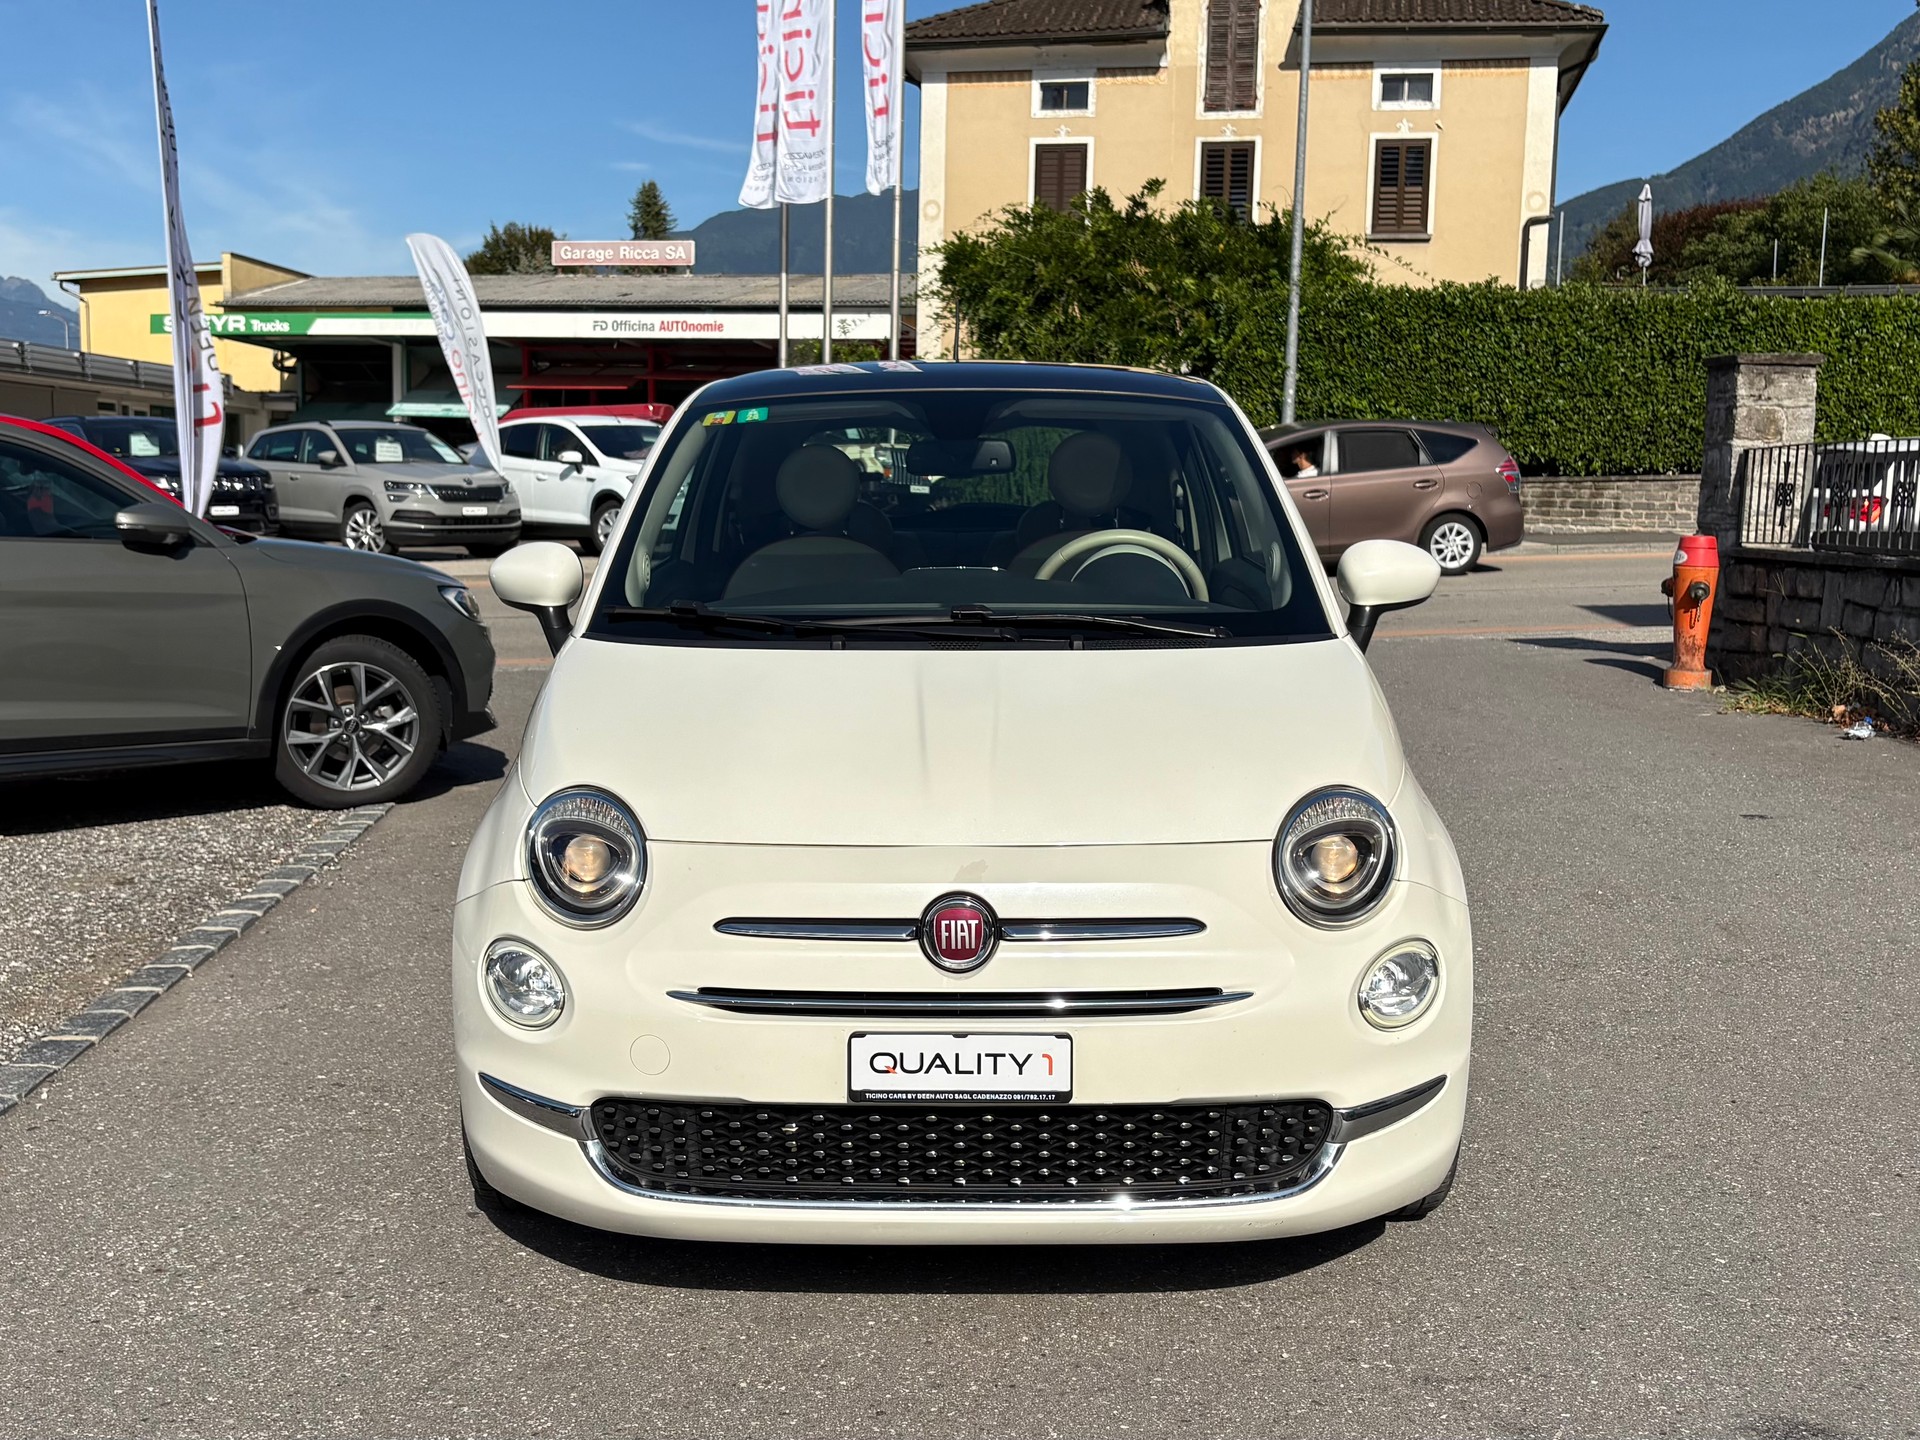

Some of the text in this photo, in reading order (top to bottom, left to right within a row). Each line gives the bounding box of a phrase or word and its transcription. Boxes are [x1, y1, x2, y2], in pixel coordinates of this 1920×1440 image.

[560, 245, 687, 263] Garage Ricca SA
[250, 318, 290, 332] Trucks
[611, 320, 655, 332] Officina
[659, 320, 724, 332] AUTOnomie
[940, 920, 979, 950] FIAT
[869, 1052, 1053, 1076] QUALITY 1
